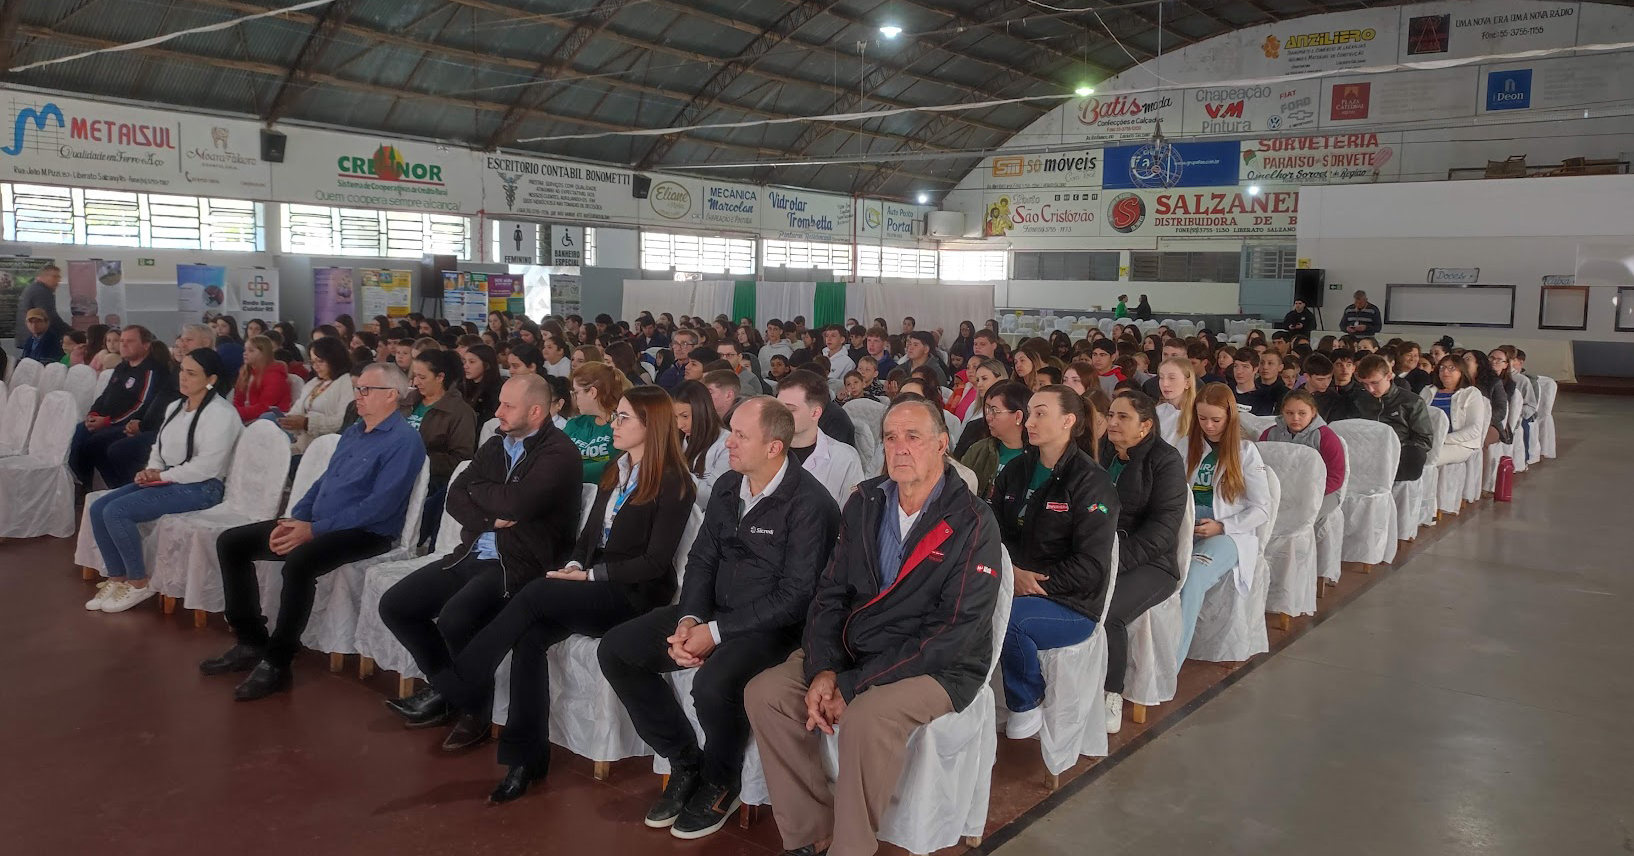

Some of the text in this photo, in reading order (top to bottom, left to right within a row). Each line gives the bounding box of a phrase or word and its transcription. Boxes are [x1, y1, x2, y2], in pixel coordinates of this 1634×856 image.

[1455, 19, 1472, 28] UMA
[1473, 17, 1491, 26] NOVA
[1493, 15, 1508, 25] ERA
[1510, 13, 1528, 23] UMA
[1529, 11, 1548, 21] NOVA
[1195, 84, 1271, 103] Chapeação
[1280, 89, 1296, 100] FIAT
[1078, 96, 1172, 126] Batis moda
[1280, 96, 1311, 114] FORD
[1097, 118, 1130, 127] Confecções
[1135, 116, 1164, 124] Calçads
[1202, 119, 1251, 133] Pintura
[70, 116, 176, 150] METALSUL
[1258, 132, 1379, 152] SORVETERIA
[59, 144, 105, 161] Qualidade
[1043, 152, 1097, 172] móveis
[1263, 155, 1315, 170] PARAISO
[72, 171, 97, 180] Liberato
[585, 169, 631, 186] BONOMETTI
[1295, 169, 1333, 180] Sorvet
[314, 188, 345, 202] Quem
[347, 192, 388, 205] coopera
[389, 195, 423, 209] sempre
[655, 185, 688, 203] Eliane
[768, 191, 808, 213] Vidrolar
[707, 197, 754, 214] Marcolan
[887, 205, 914, 218] Auto Posto
[1011, 204, 1095, 224] São Cristóvão
[786, 211, 833, 231] Trombetta
[1154, 215, 1238, 227] DISTRIBUIDORA
[1253, 216, 1273, 226] DE
[504, 255, 532, 265] FEMININO
[554, 249, 581, 259] BANHEIRO
[555, 258, 580, 267] ESPECIAL
[596, 434, 611, 443] DE
